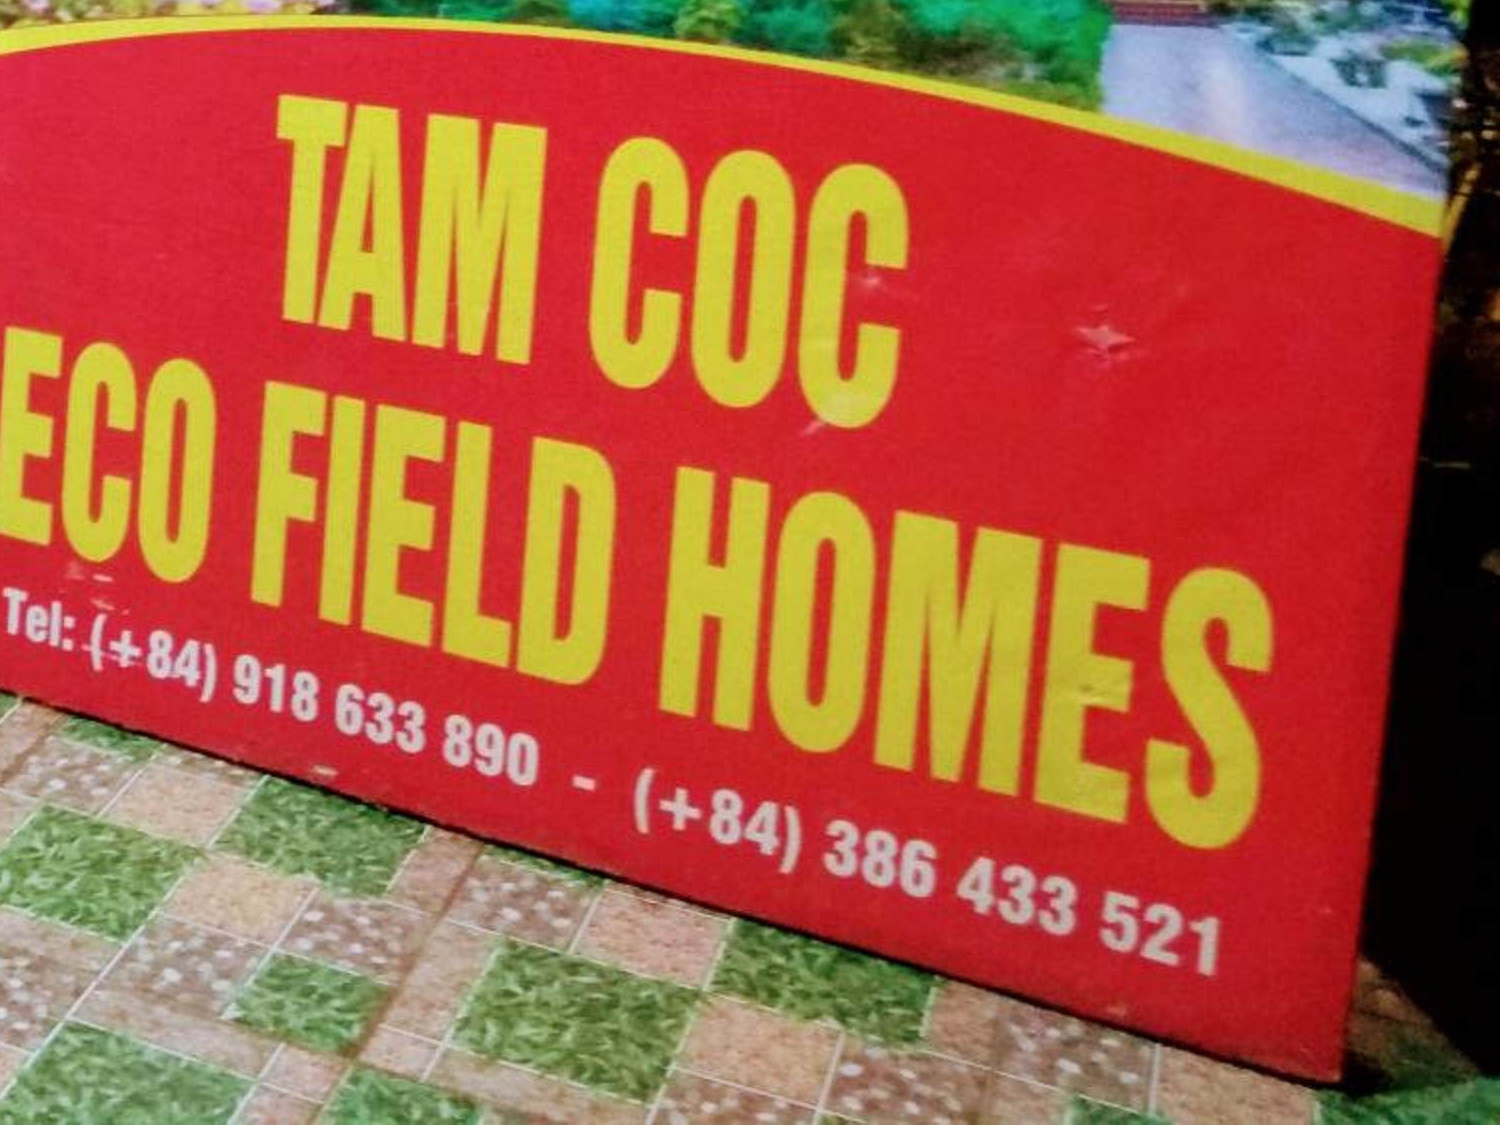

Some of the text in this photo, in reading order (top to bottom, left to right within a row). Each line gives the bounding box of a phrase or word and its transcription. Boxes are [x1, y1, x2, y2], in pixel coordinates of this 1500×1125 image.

[277, 94, 910, 430] TAM COC
[2, 587, 75, 651] Tel:
[88, 615, 218, 703] (+84)
[234, 655, 319, 720] 918
[334, 683, 428, 754] 633
[443, 712, 539, 786] 890
[633, 766, 802, 874] (+84)
[824, 818, 937, 898] 386
[957, 856, 1078, 937] 433
[1100, 891, 1221, 977] 521
[251, 381, 616, 686] FIELD
[660, 467, 1274, 851] HOMES
